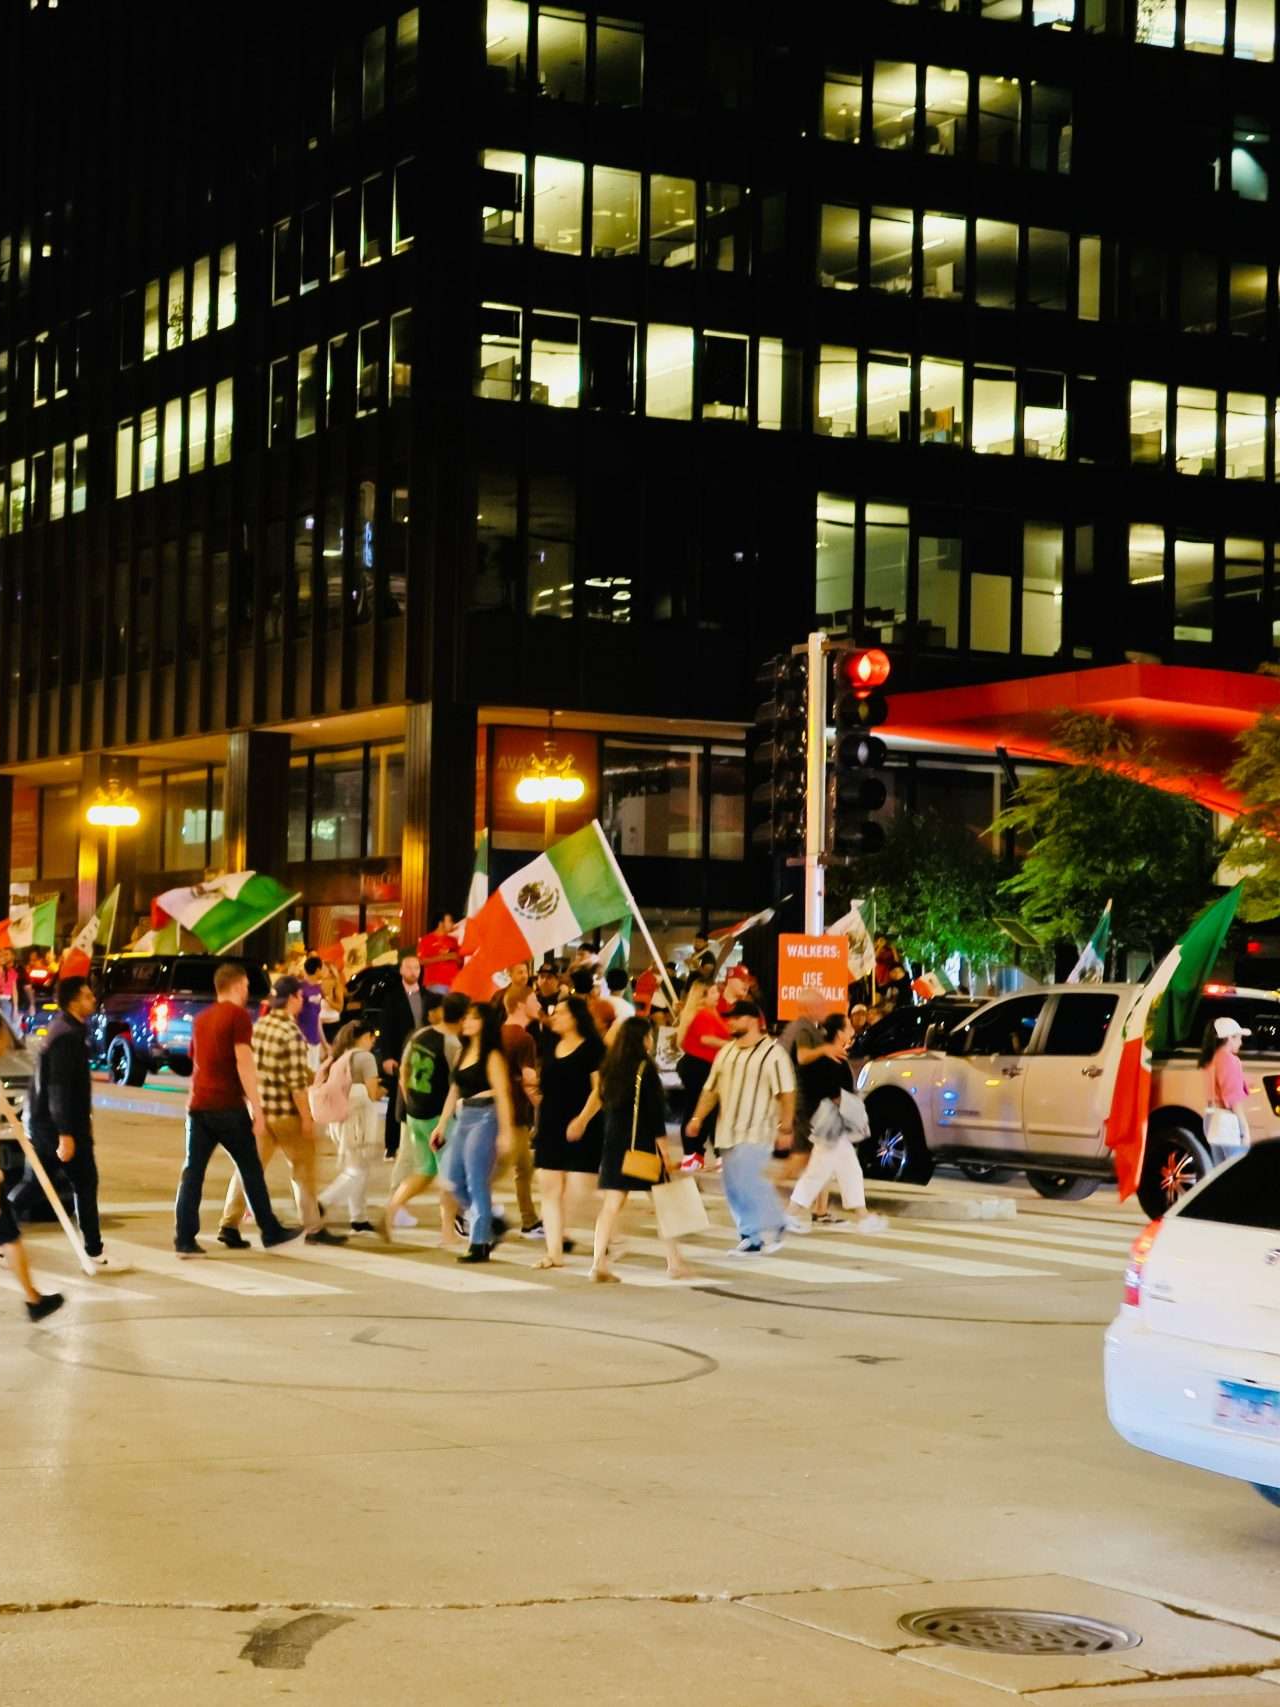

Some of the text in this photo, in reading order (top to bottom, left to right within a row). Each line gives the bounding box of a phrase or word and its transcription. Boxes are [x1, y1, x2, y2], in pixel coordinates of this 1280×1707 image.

[787, 944, 840, 959] WALKERS:
[802, 972, 824, 985] USE
[781, 985, 845, 1000] CROWALK
